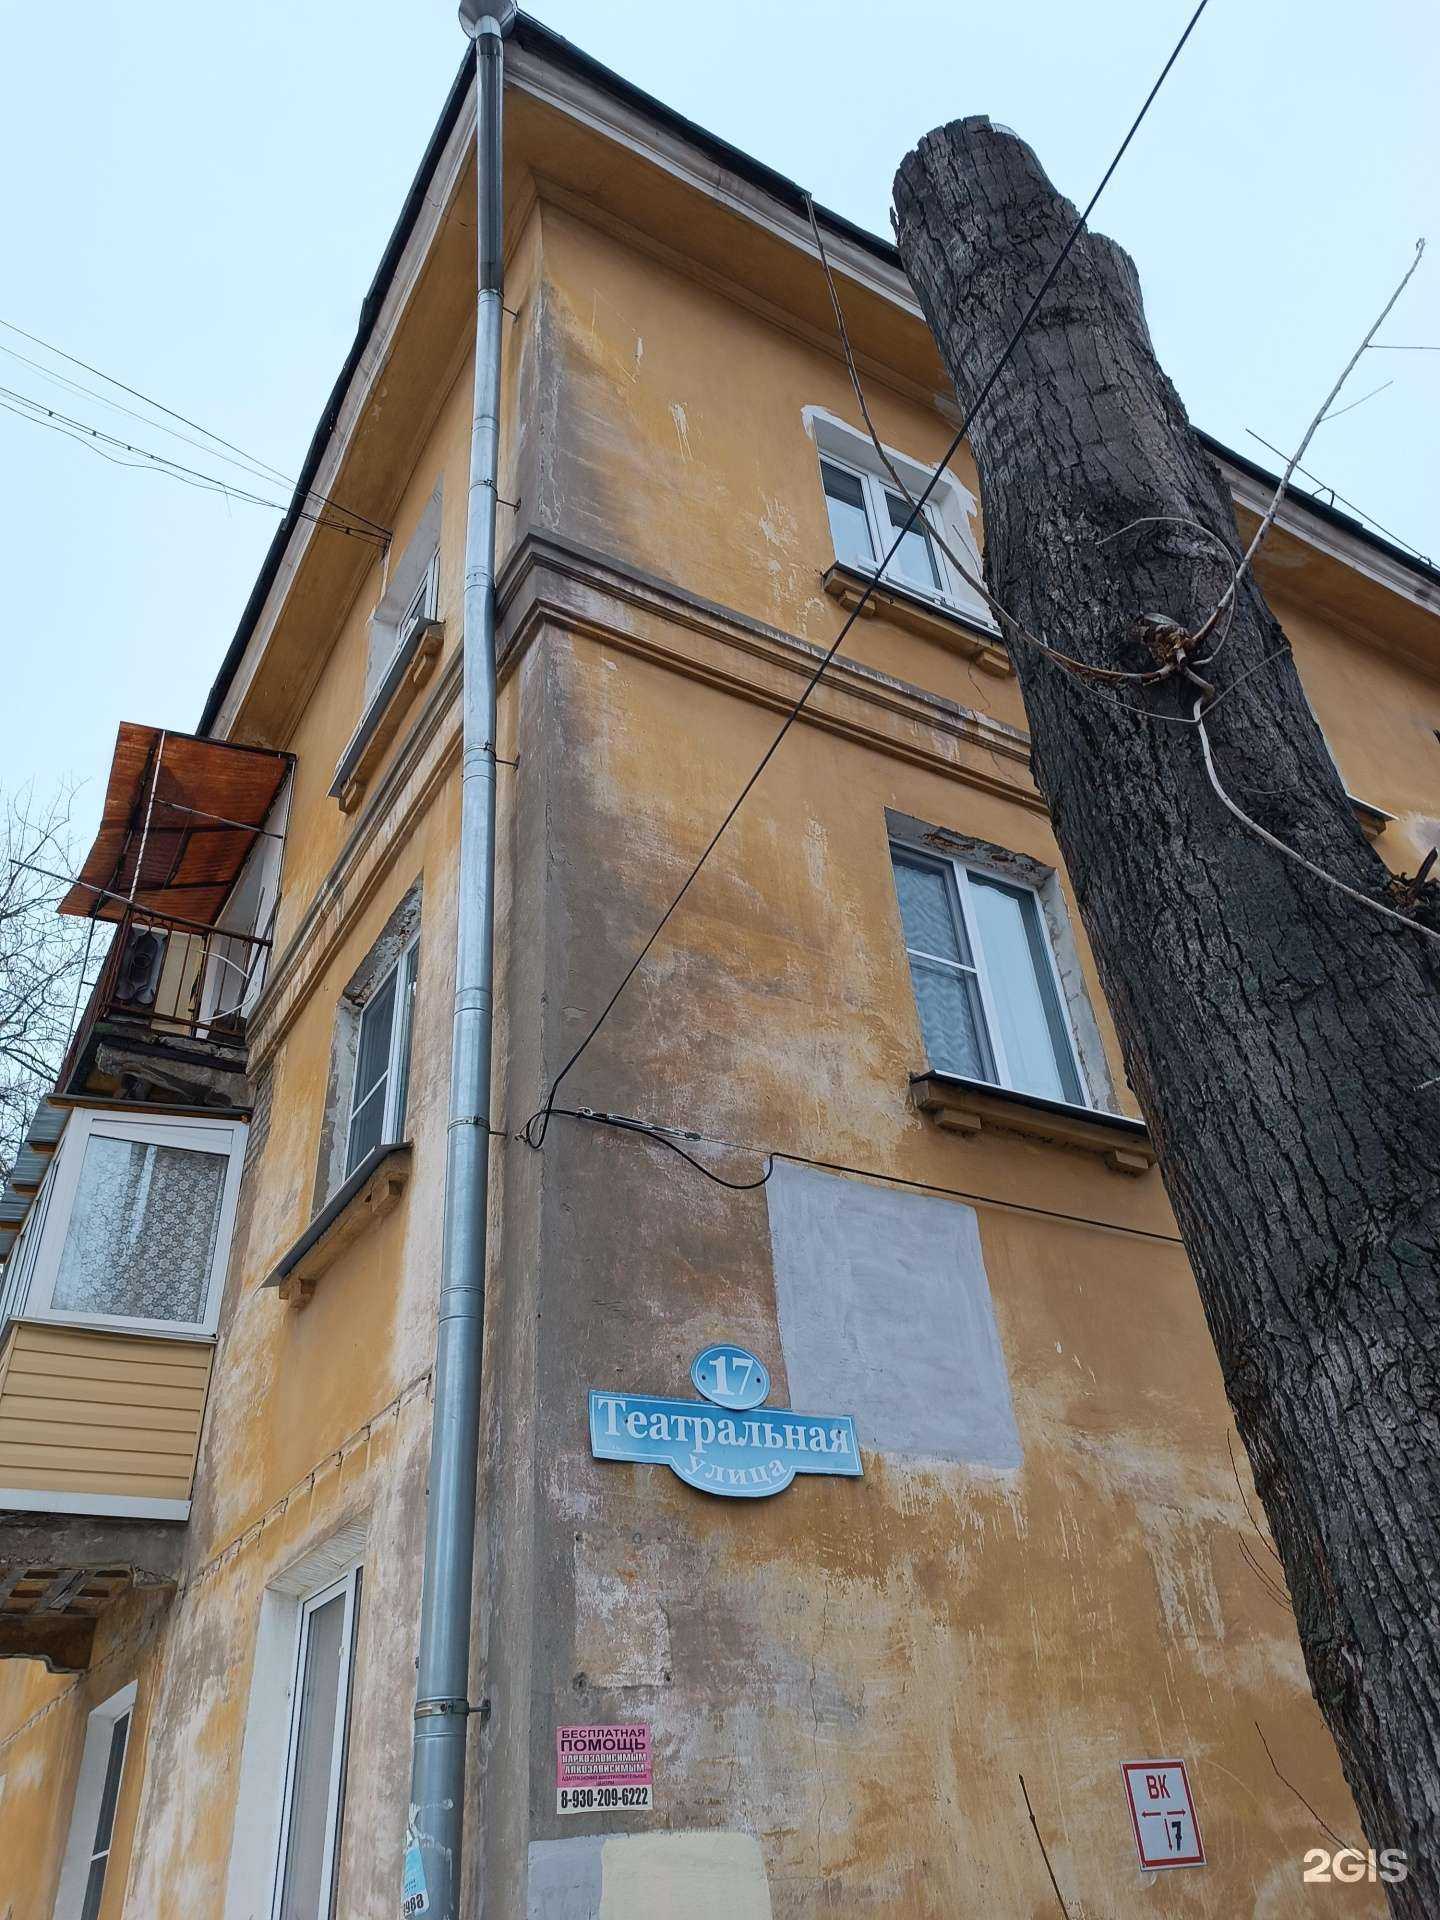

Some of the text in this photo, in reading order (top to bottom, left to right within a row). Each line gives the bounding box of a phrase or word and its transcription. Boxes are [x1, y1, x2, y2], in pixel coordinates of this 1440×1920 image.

[708, 1355, 754, 1396] 17
[597, 1398, 851, 1454] Театральная
[560, 1738, 647, 1752] ПОМОЩЬ
[561, 1728, 646, 1739] БЕСПЛАТНАЯ
[561, 1787, 648, 1808] 8-930-209-6222
[1145, 1774, 1171, 1799] ВК
